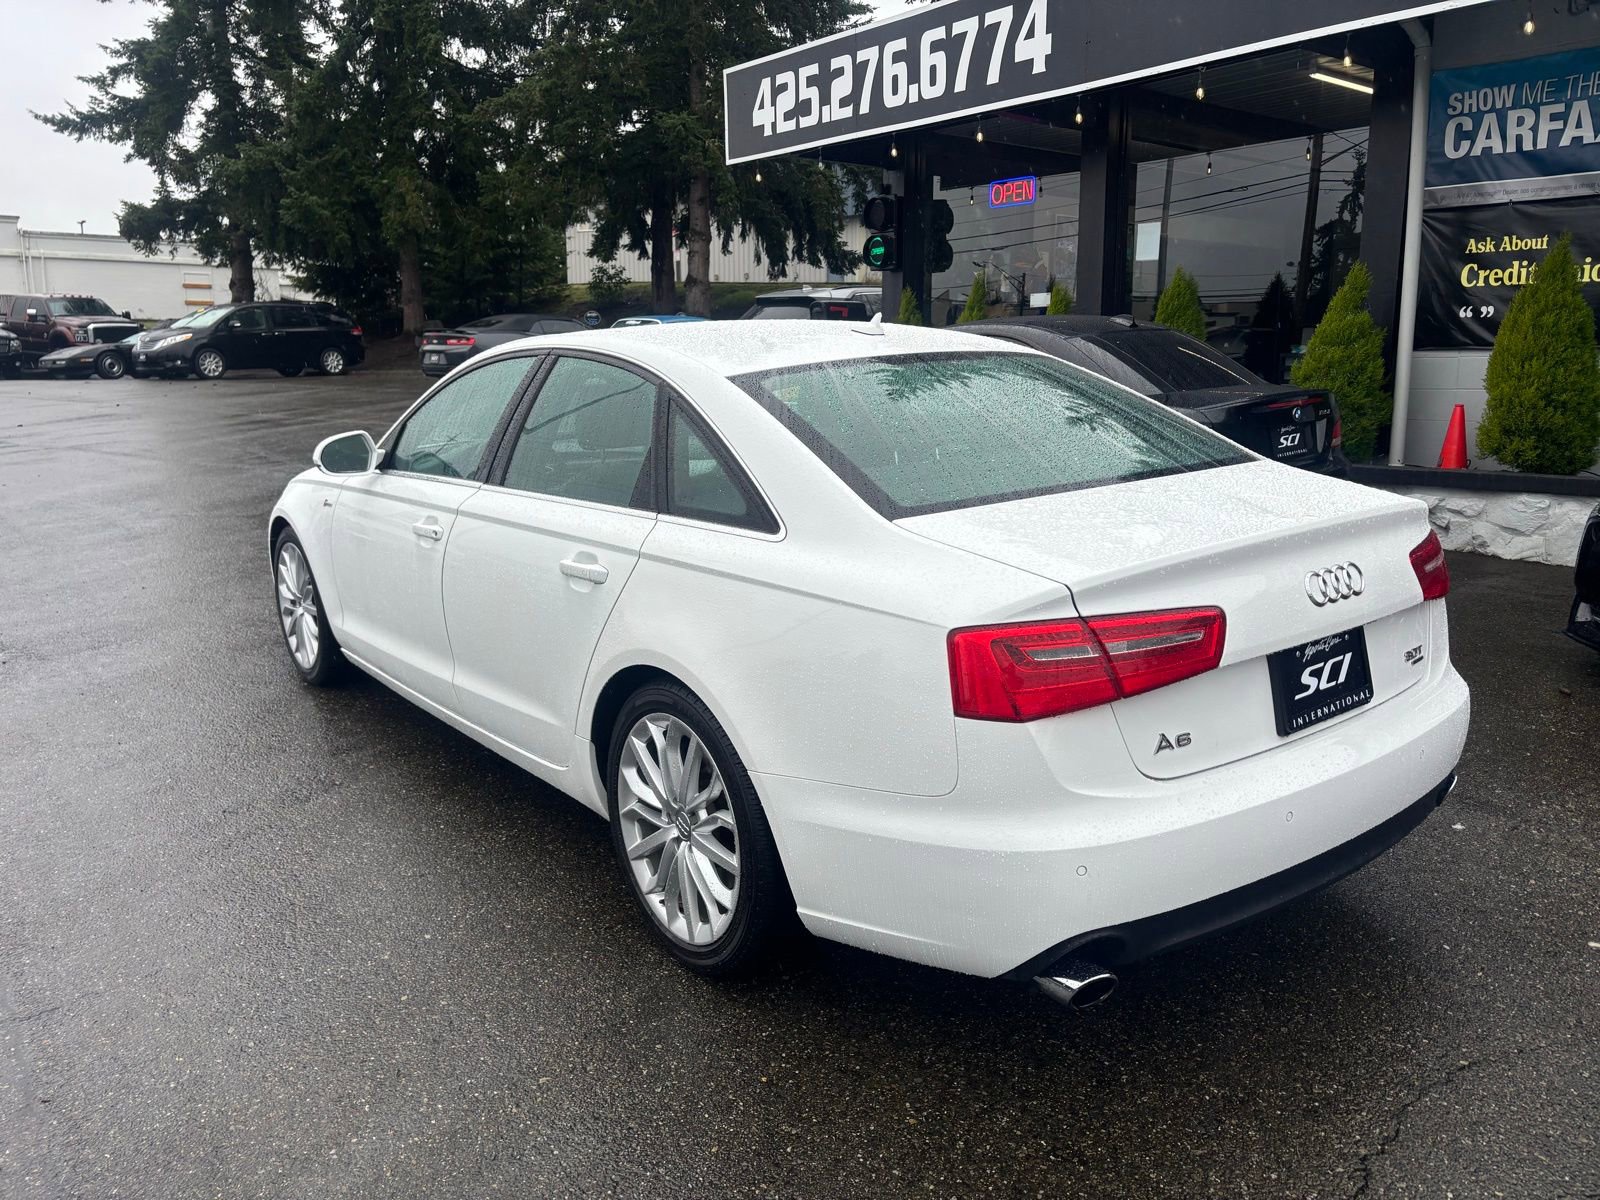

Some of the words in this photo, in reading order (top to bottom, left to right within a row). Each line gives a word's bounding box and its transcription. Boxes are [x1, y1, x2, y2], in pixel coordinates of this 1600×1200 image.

[752, 0, 1052, 137] 425.276.6774
[1447, 83, 1516, 116] SHOW
[1522, 78, 1559, 105] ME
[1444, 99, 1600, 160] CARFA
[991, 179, 1034, 205] OPEN
[1465, 237, 1496, 254] Ask
[1499, 234, 1550, 252] About
[1277, 432, 1301, 449] SCI
[1294, 652, 1353, 701] SCI
[1293, 688, 1371, 728] INTERNATIONAL
[1153, 732, 1192, 755] A6
